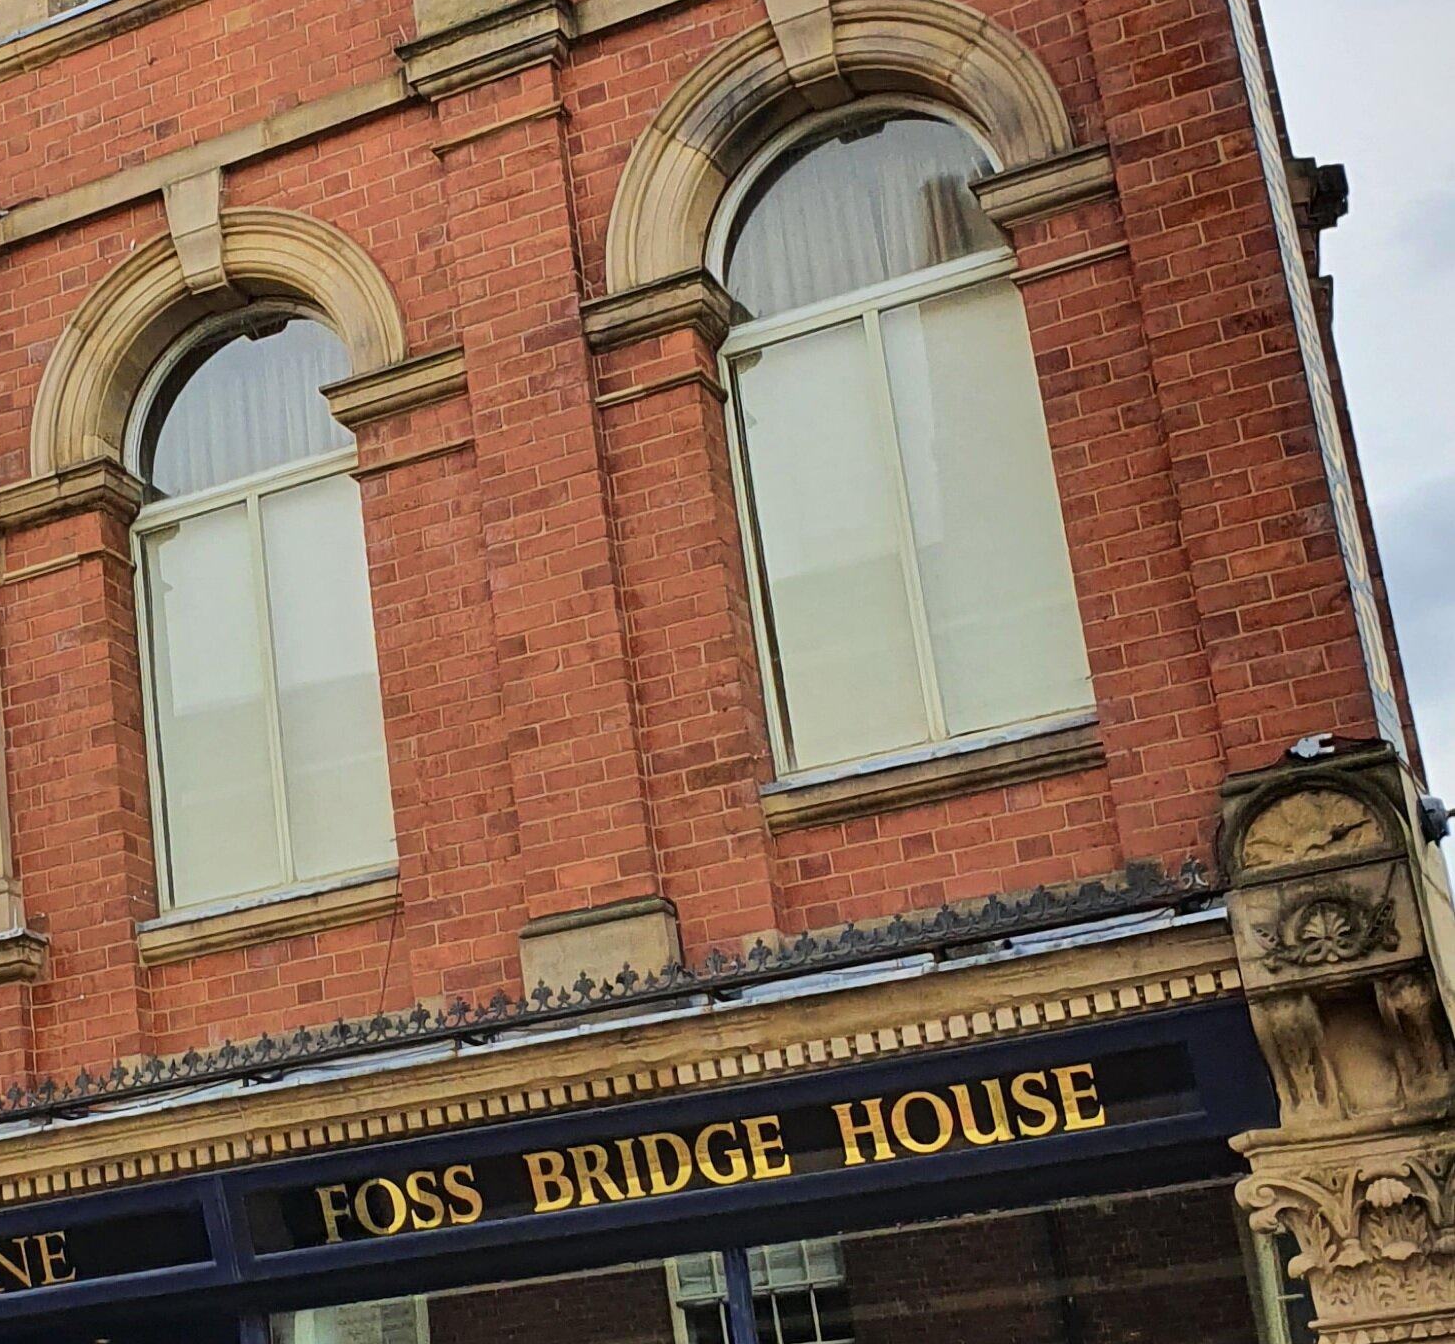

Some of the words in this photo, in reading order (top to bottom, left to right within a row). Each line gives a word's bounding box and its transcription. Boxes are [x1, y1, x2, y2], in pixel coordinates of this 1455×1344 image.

[316, 1165, 485, 1245] FOSS
[522, 1114, 792, 1214] BRIDGE
[832, 1062, 1108, 1167] HOUSE
